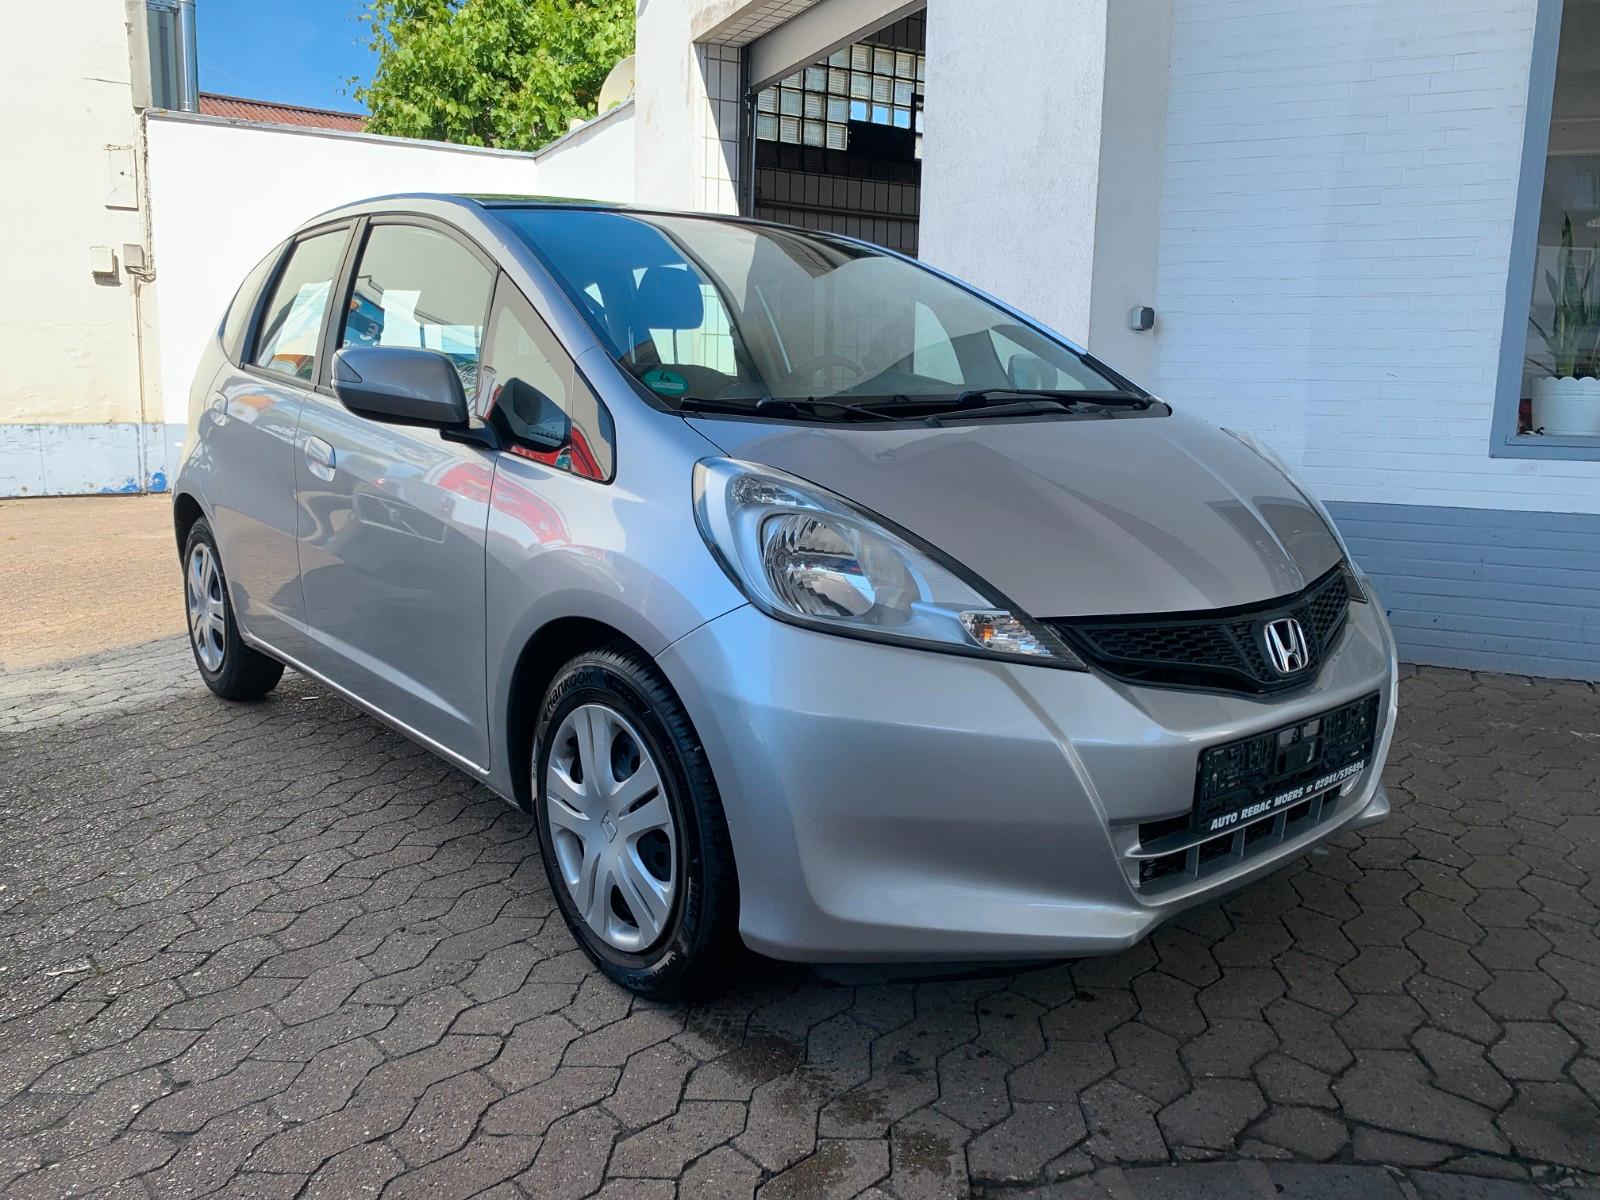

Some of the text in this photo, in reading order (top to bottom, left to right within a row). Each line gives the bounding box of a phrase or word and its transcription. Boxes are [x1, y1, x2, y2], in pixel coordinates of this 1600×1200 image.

[1210, 812, 1238, 830] AUTO
[1240, 799, 1272, 820] REBAC
[1273, 786, 1304, 808] MOERS
